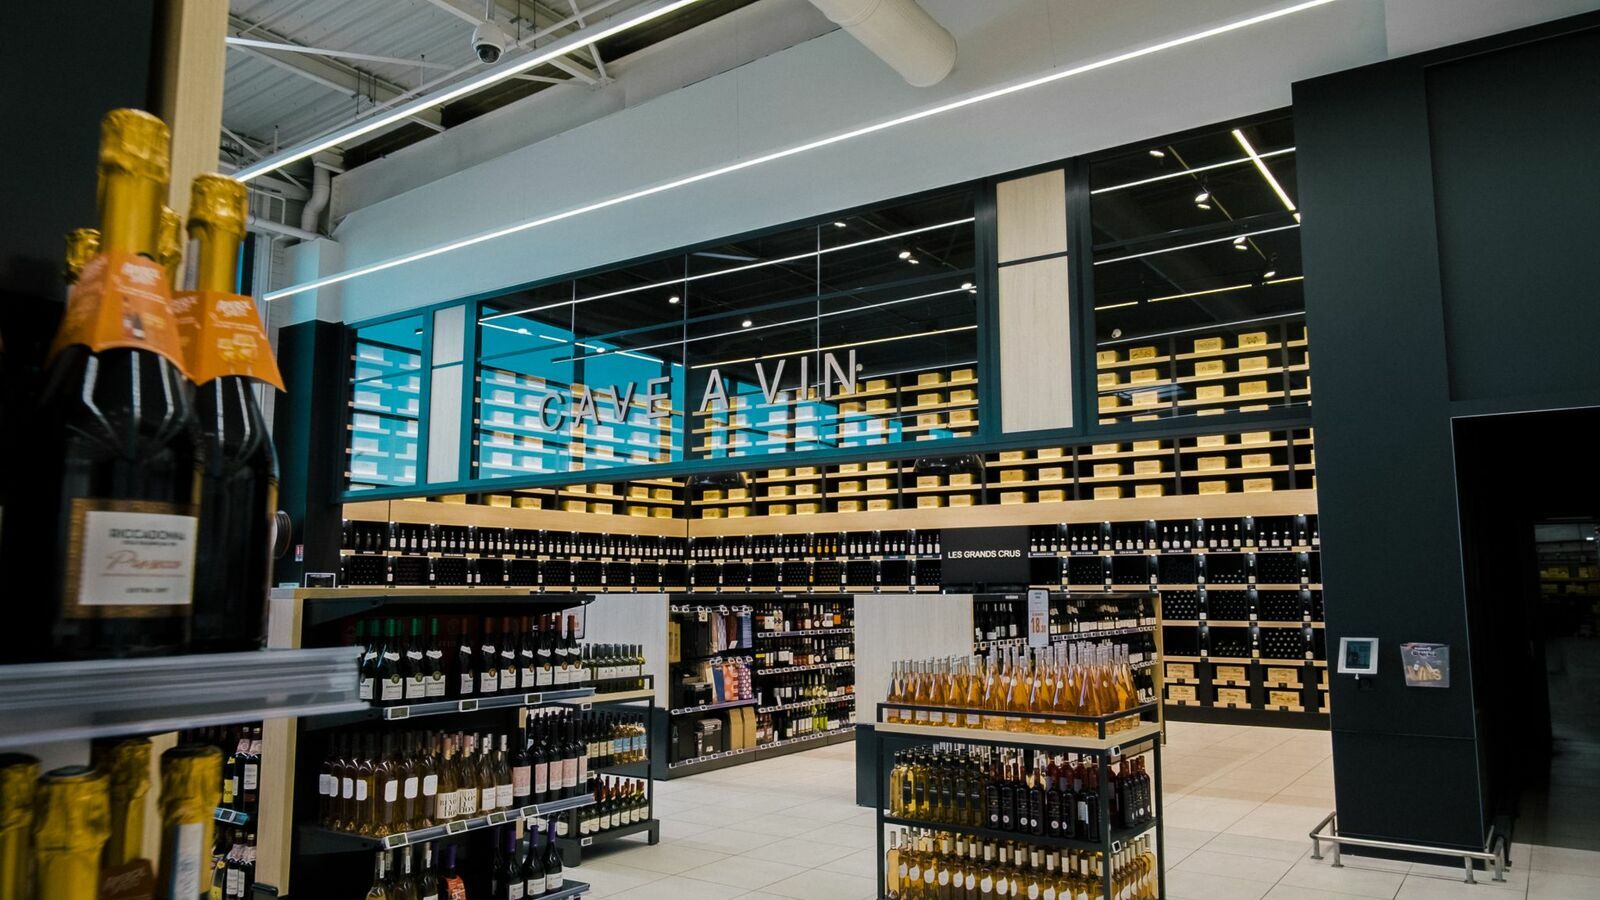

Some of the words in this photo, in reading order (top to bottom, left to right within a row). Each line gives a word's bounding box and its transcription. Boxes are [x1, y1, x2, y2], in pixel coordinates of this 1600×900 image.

[539, 376, 671, 431] CAVE
[699, 368, 730, 412] A
[755, 349, 857, 405] VIN
[947, 551, 963, 559] LES
[963, 550, 997, 559] GRANDS
[997, 549, 1021, 558] CRUS
